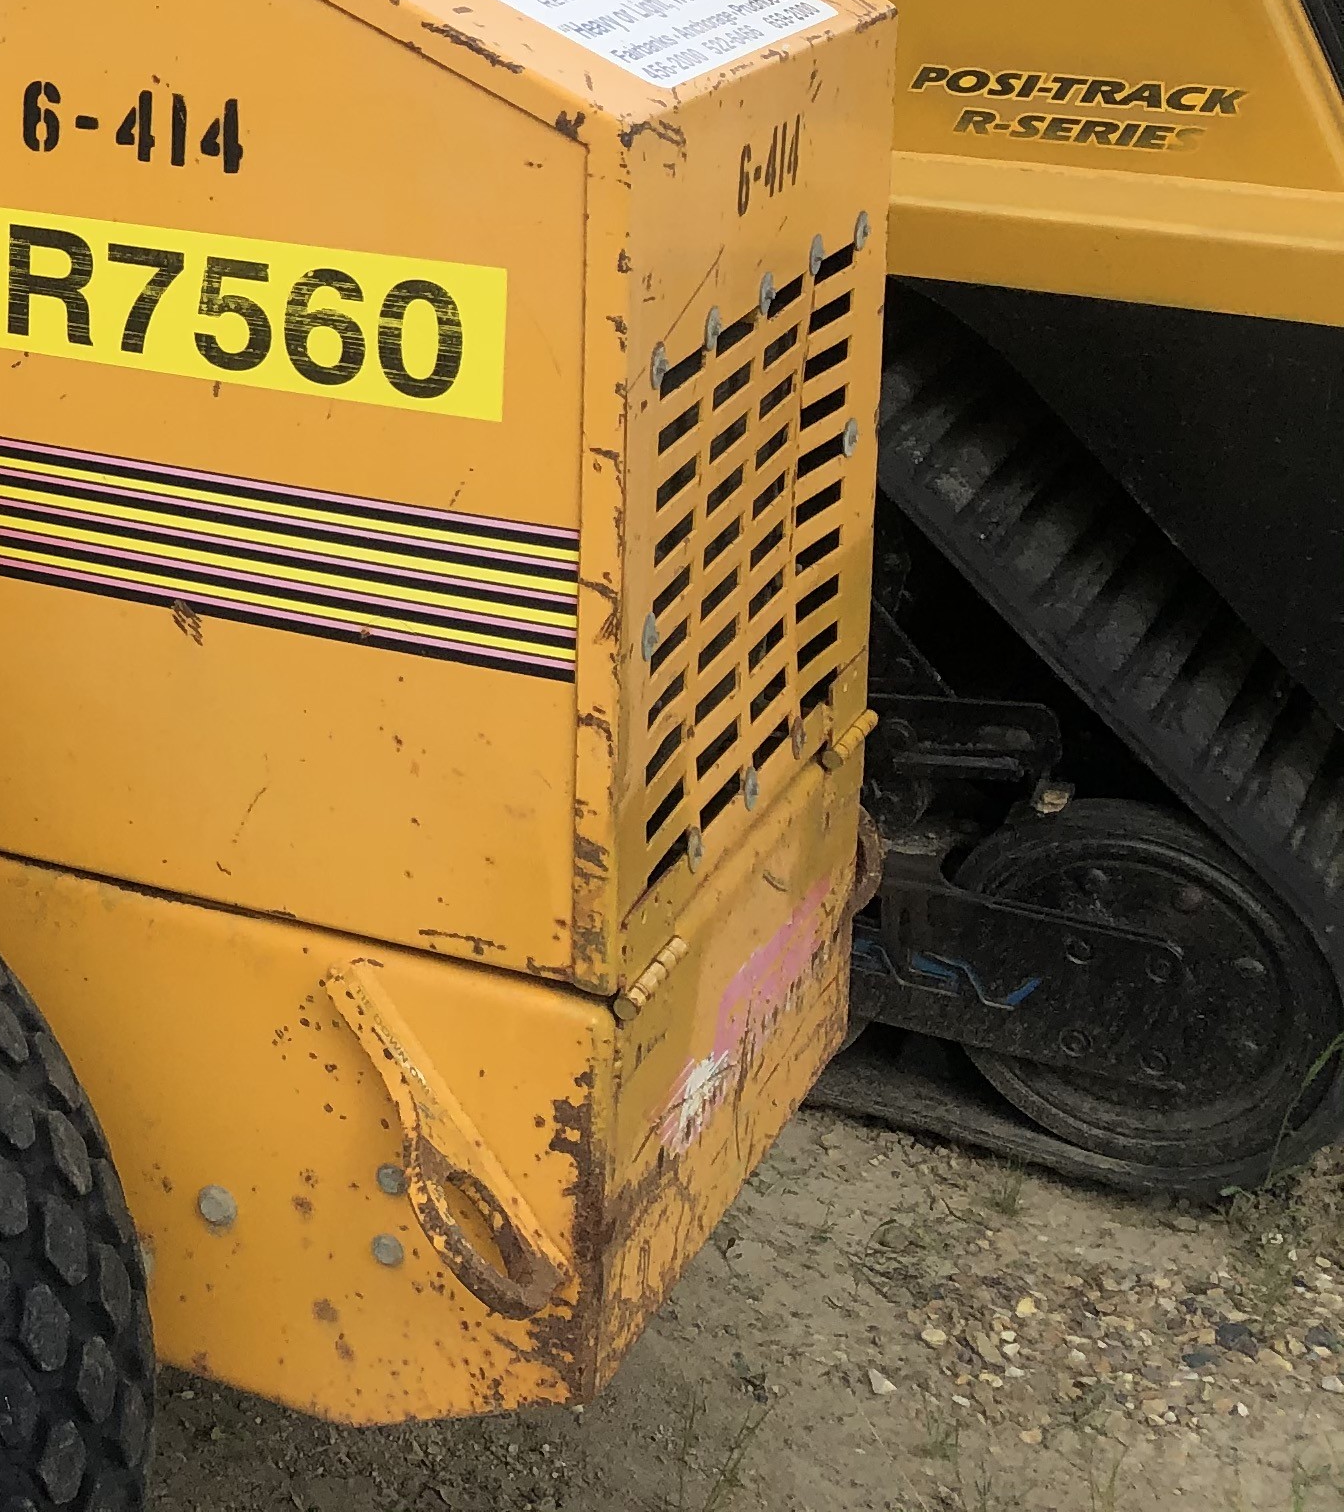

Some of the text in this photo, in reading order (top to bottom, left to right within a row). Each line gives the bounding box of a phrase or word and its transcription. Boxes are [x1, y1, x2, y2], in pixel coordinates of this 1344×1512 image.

[610, 34, 679, 63] Fairbanks
[671, 11, 738, 40] Anchorage
[642, 48, 710, 79] 456-2000
[908, 64, 1249, 117] POSI-TRACK
[23, 80, 243, 174] 6-414
[953, 107, 1207, 151] R-SERIES
[7, 224, 463, 399] R7560
